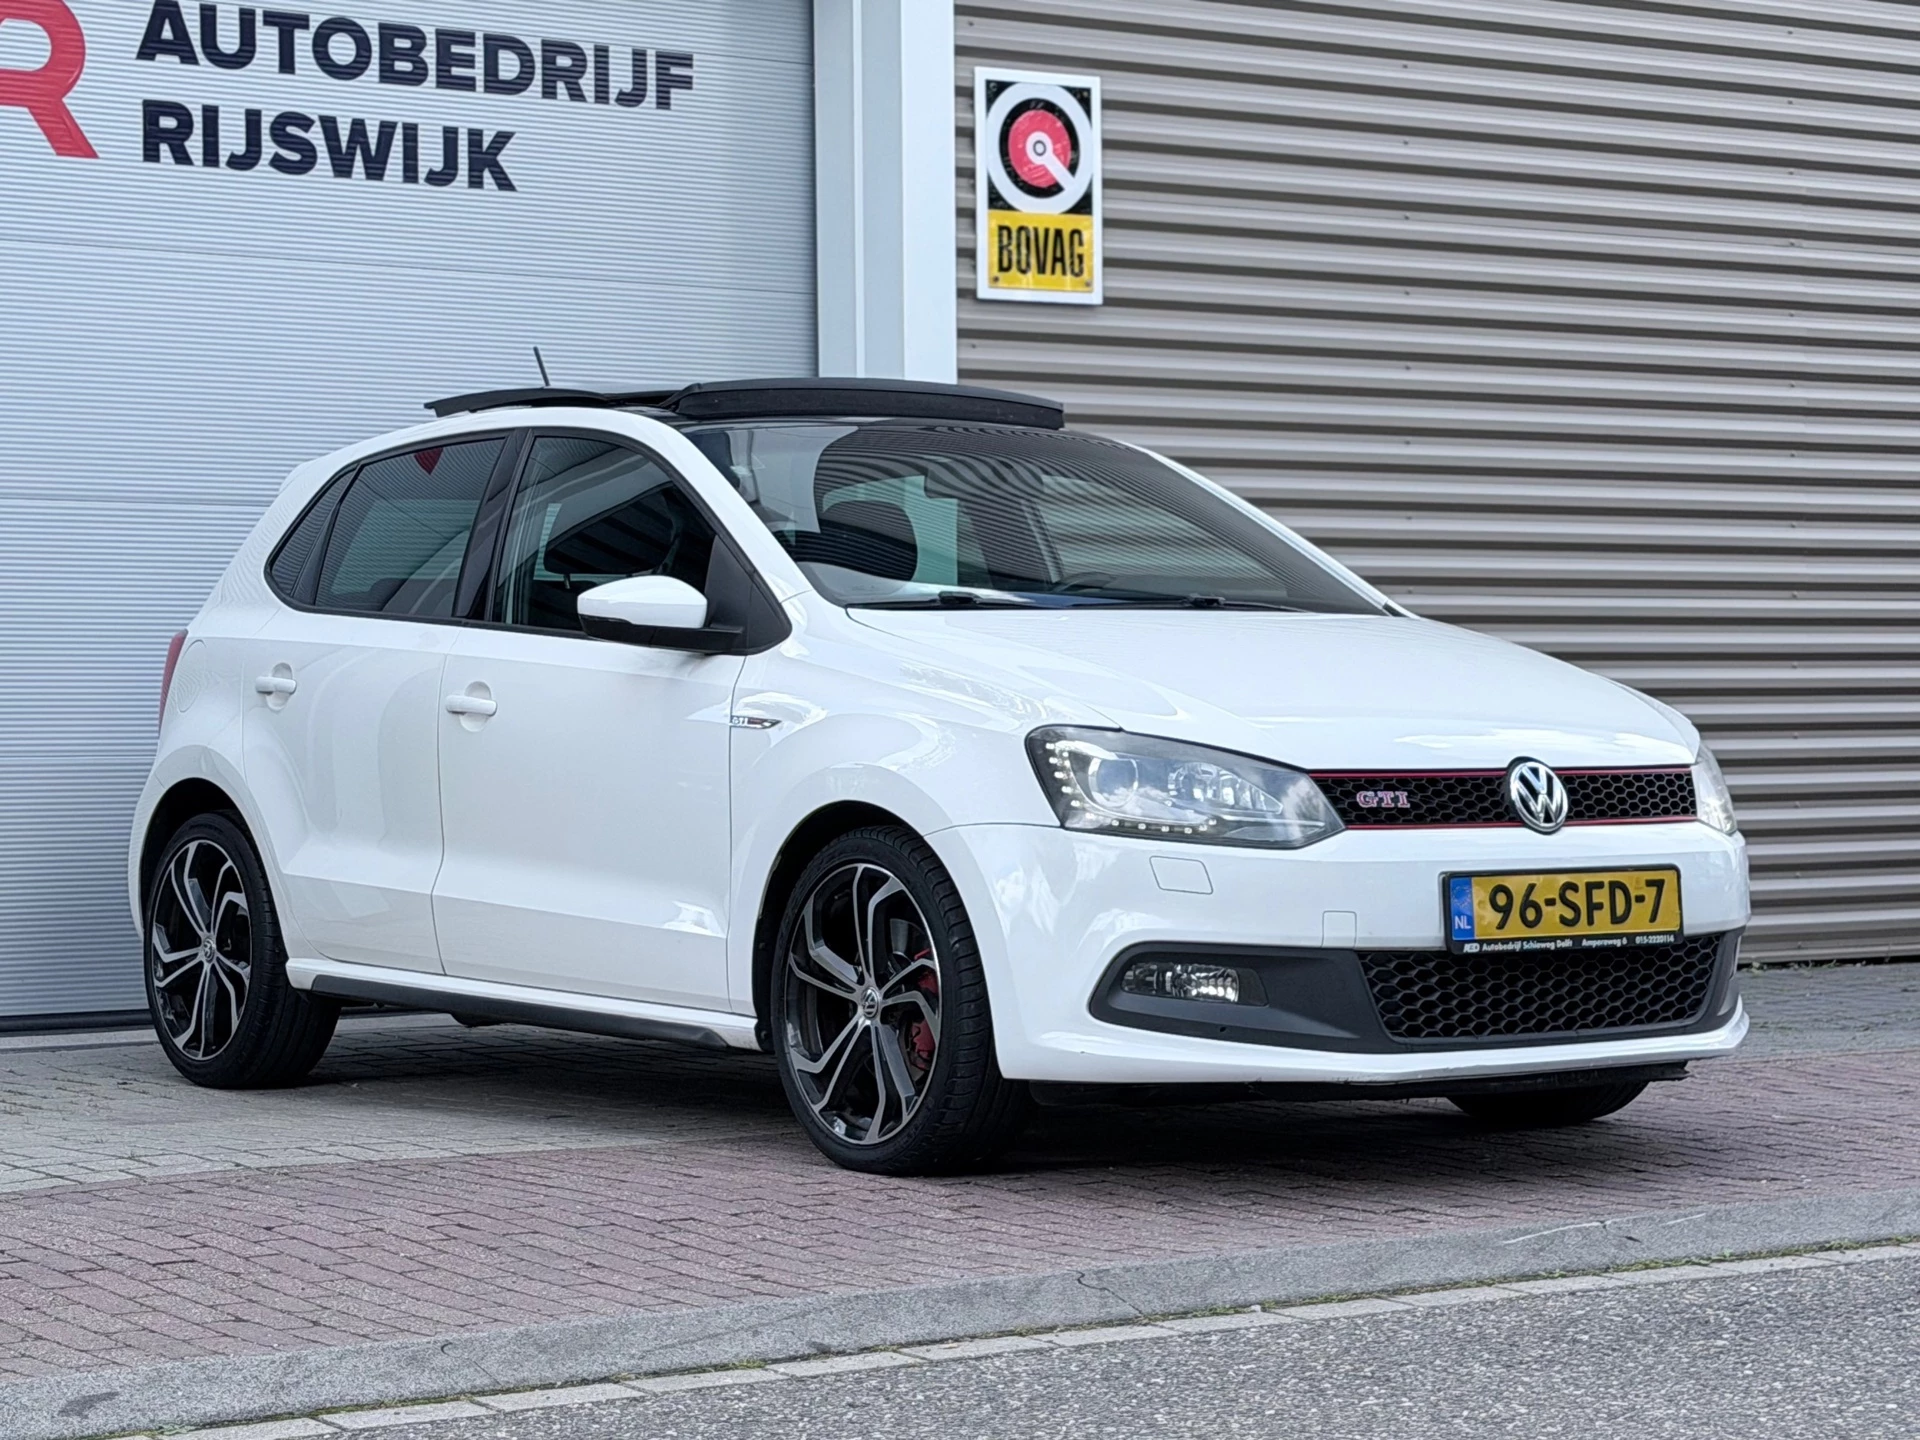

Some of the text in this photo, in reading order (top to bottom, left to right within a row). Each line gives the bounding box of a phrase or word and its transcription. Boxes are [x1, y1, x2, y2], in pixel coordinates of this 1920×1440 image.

[136, 0, 694, 110] AUTOBEDRIJF
[142, 99, 518, 192] RIJSWIJK
[997, 224, 1085, 278] BOVAG
[1356, 790, 1411, 808] GTI
[1454, 915, 1472, 930] NL
[1489, 878, 1666, 930] 96-SFD-7
